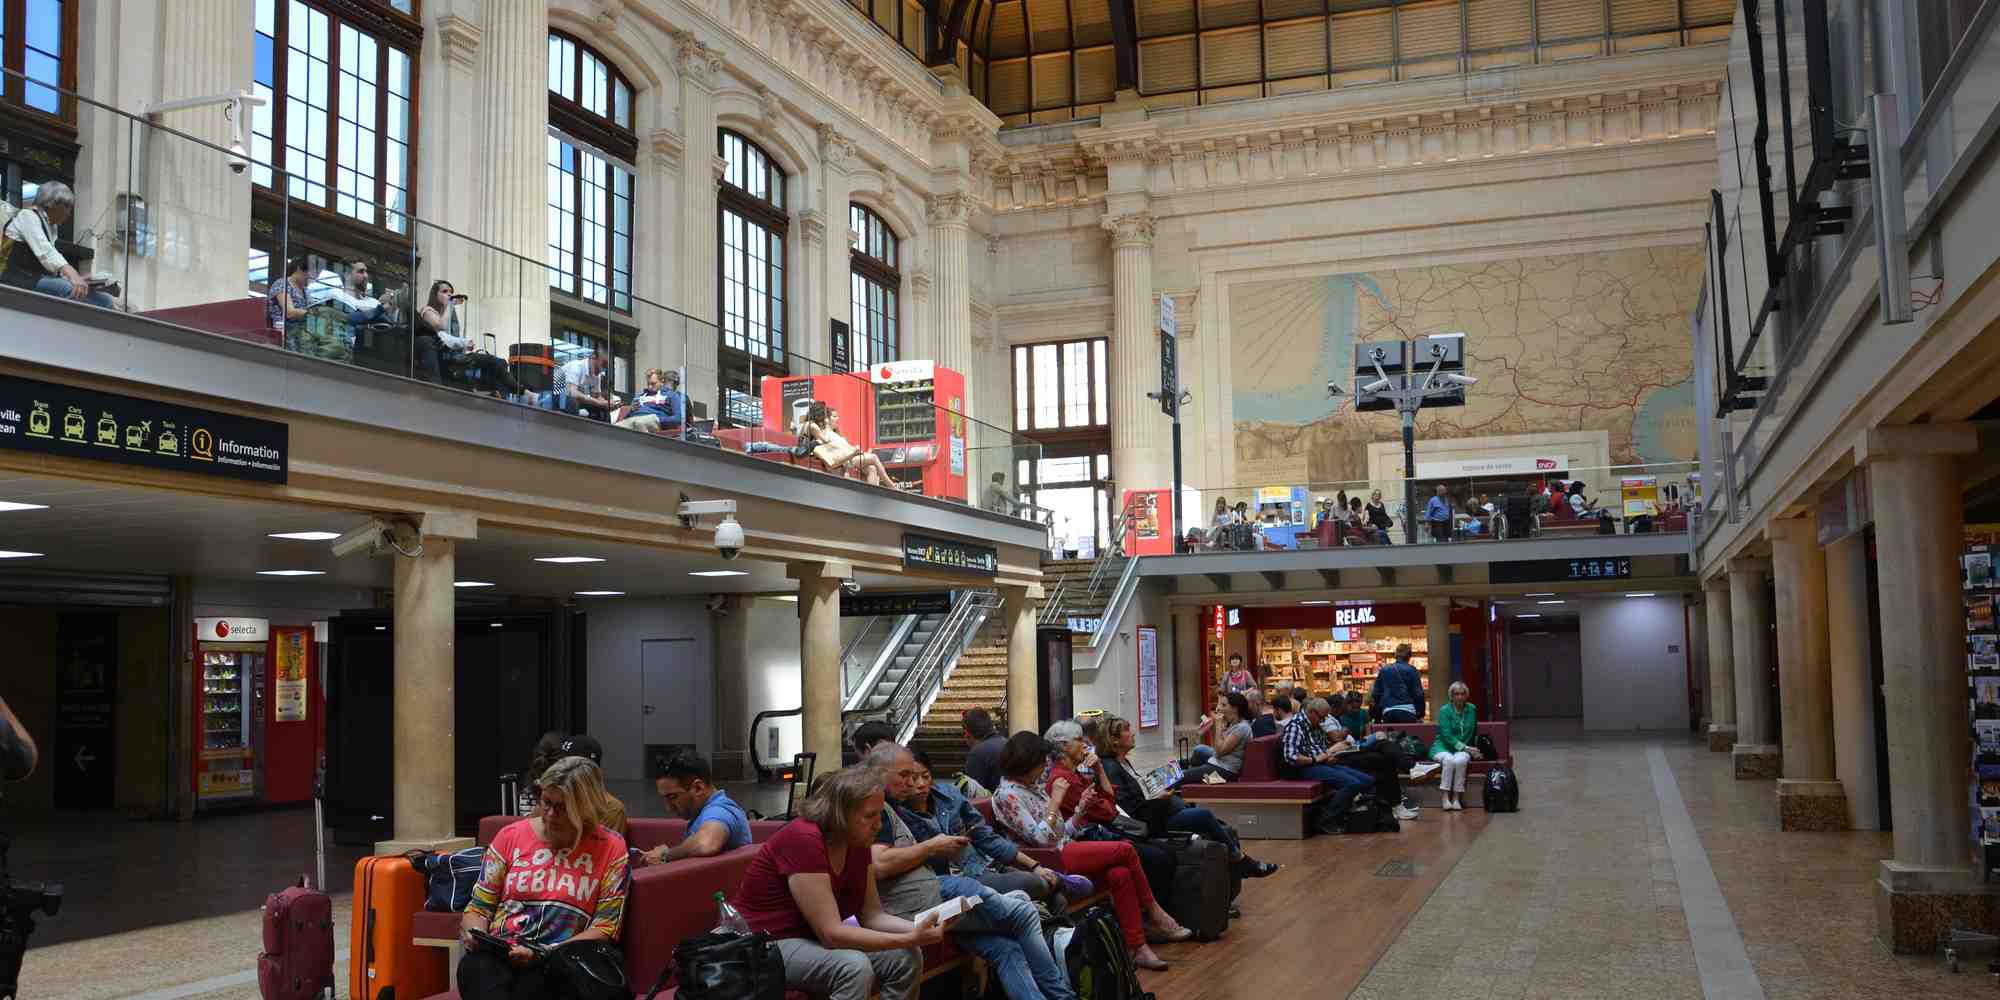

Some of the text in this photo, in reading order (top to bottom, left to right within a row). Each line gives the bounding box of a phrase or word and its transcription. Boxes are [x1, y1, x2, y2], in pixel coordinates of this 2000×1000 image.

[218, 438, 279, 459] Information
[230, 622, 257, 635] selecta
[511, 847, 594, 874] LORA
[504, 866, 599, 902] FEBIAN
